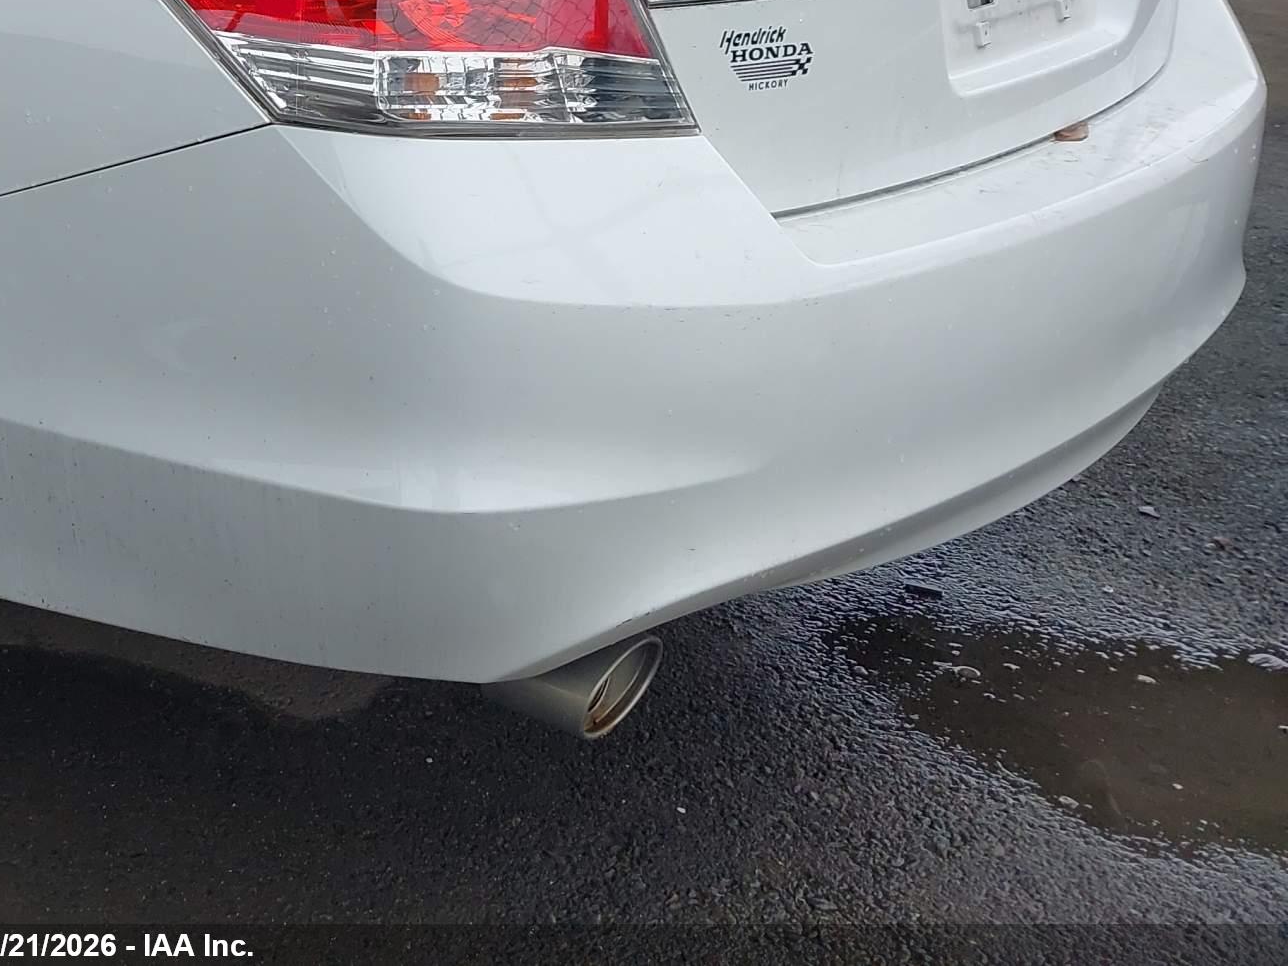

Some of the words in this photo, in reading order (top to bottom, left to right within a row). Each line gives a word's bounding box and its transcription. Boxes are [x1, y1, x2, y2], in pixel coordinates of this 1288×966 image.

[720, 25, 787, 54] Hendrick
[730, 42, 813, 63] HONDA
[748, 79, 789, 90] HICKORY
